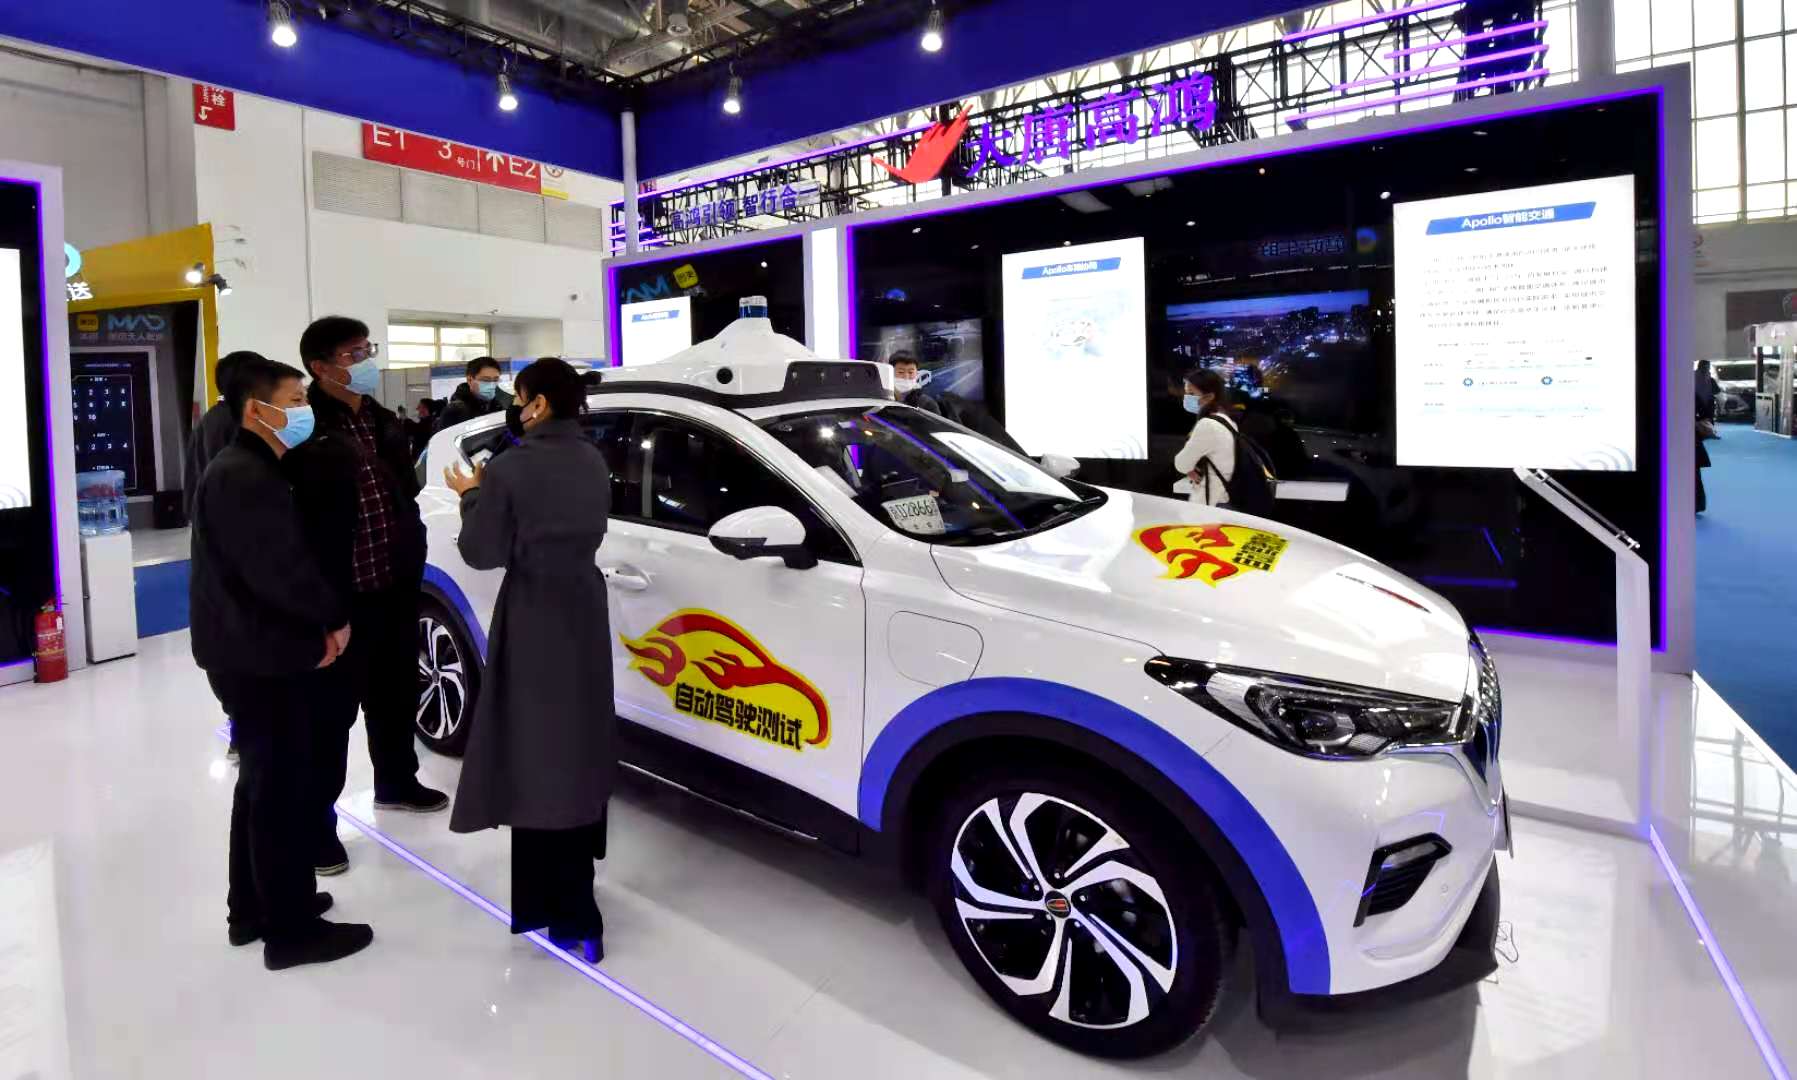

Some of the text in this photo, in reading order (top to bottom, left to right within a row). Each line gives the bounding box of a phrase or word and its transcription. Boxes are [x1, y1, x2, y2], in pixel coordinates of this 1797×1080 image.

[373, 125, 404, 150] E1
[964, 71, 1217, 178] 大唐高鸿
[508, 155, 537, 178] E2
[671, 184, 818, 231] 高鸿引领 智行合一
[1461, 207, 1555, 230] Apollo智能交通
[675, 682, 803, 751] 自动驾驶测试
